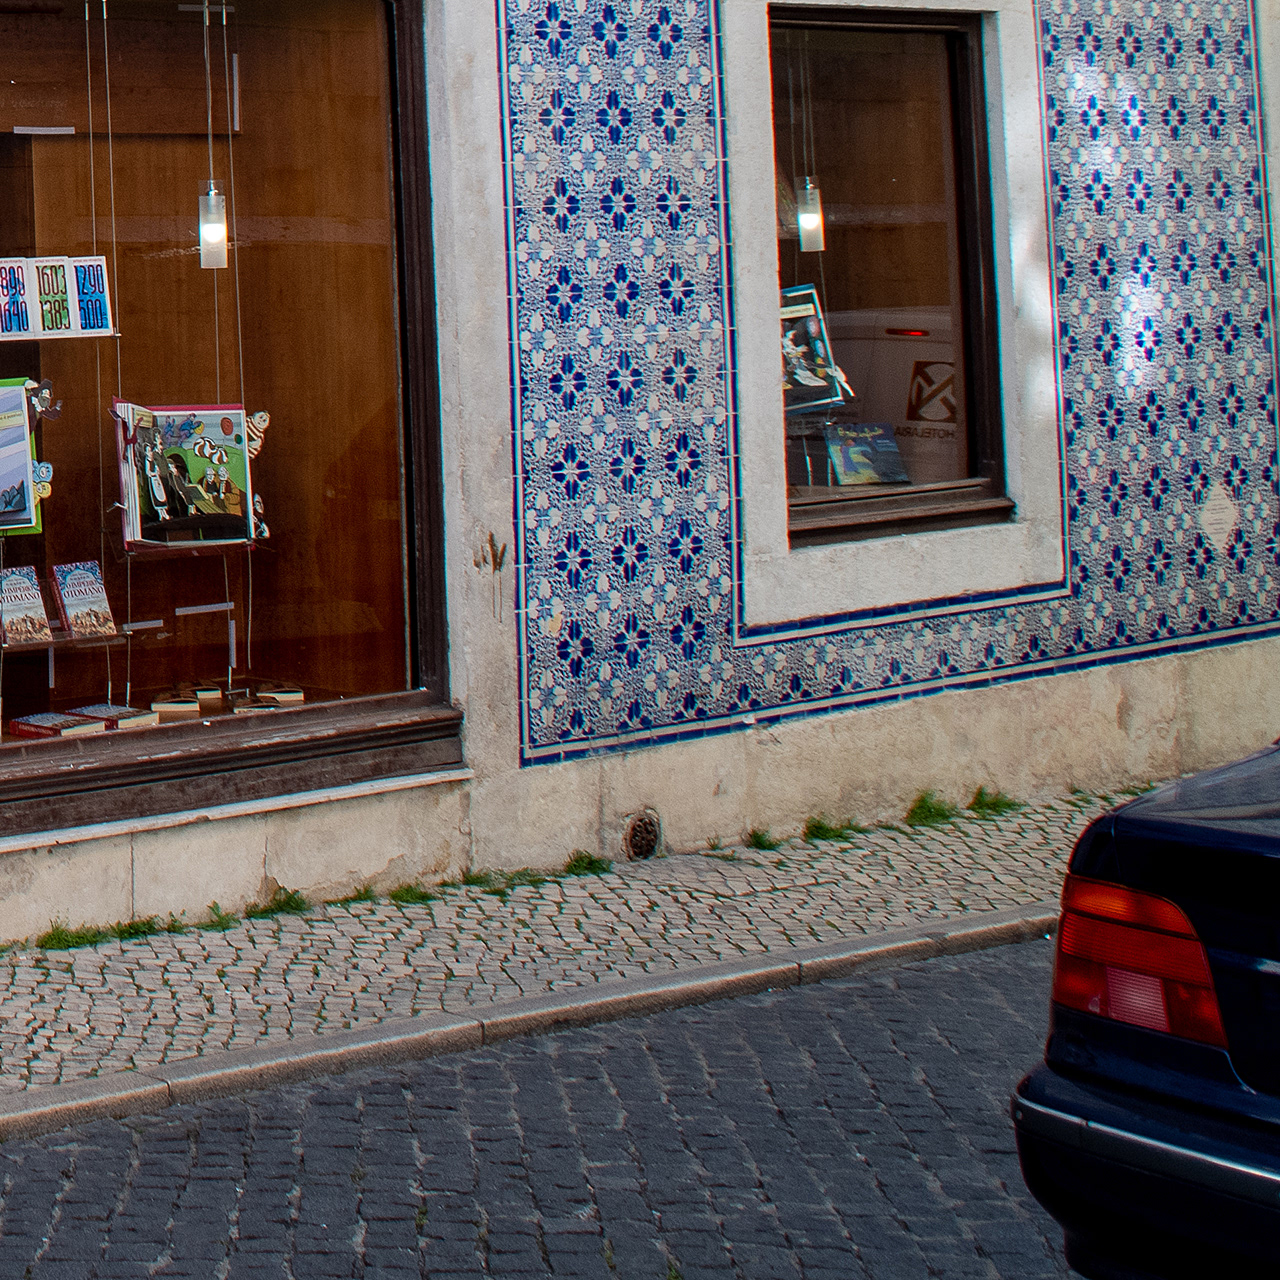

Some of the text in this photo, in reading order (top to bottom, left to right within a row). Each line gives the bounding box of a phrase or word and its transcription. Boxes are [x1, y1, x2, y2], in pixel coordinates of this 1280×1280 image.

[36, 264, 66, 296] 1603
[74, 264, 105, 295] 1290
[39, 300, 71, 331] 1385
[79, 299, 103, 329] 500
[0, 591, 40, 603] OTOMANO
[64, 585, 104, 598] OTOMANO
